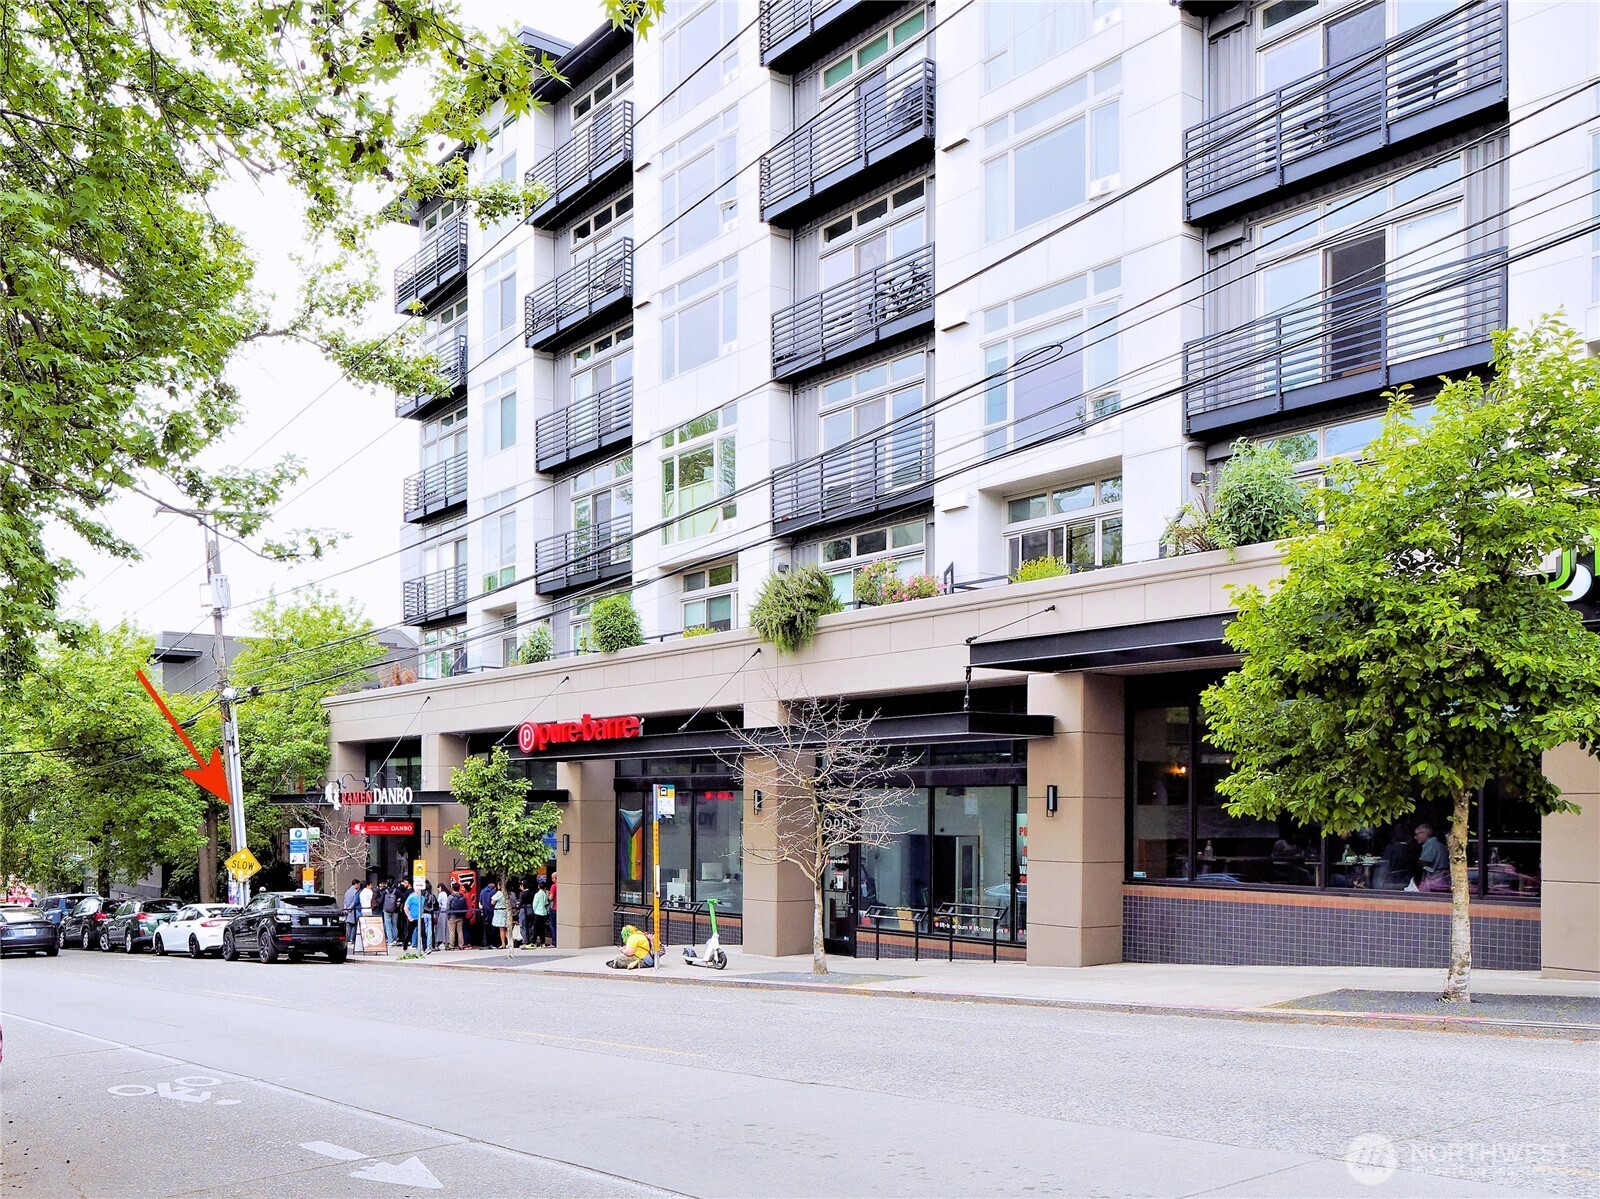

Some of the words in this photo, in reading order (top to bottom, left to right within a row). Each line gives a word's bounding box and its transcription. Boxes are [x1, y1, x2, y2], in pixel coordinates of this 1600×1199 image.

[538, 721, 581, 750] pure
[582, 714, 640, 741] barre
[341, 790, 373, 805] RAMEN
[373, 787, 413, 805] DANBO
[231, 859, 255, 870] SLOW
